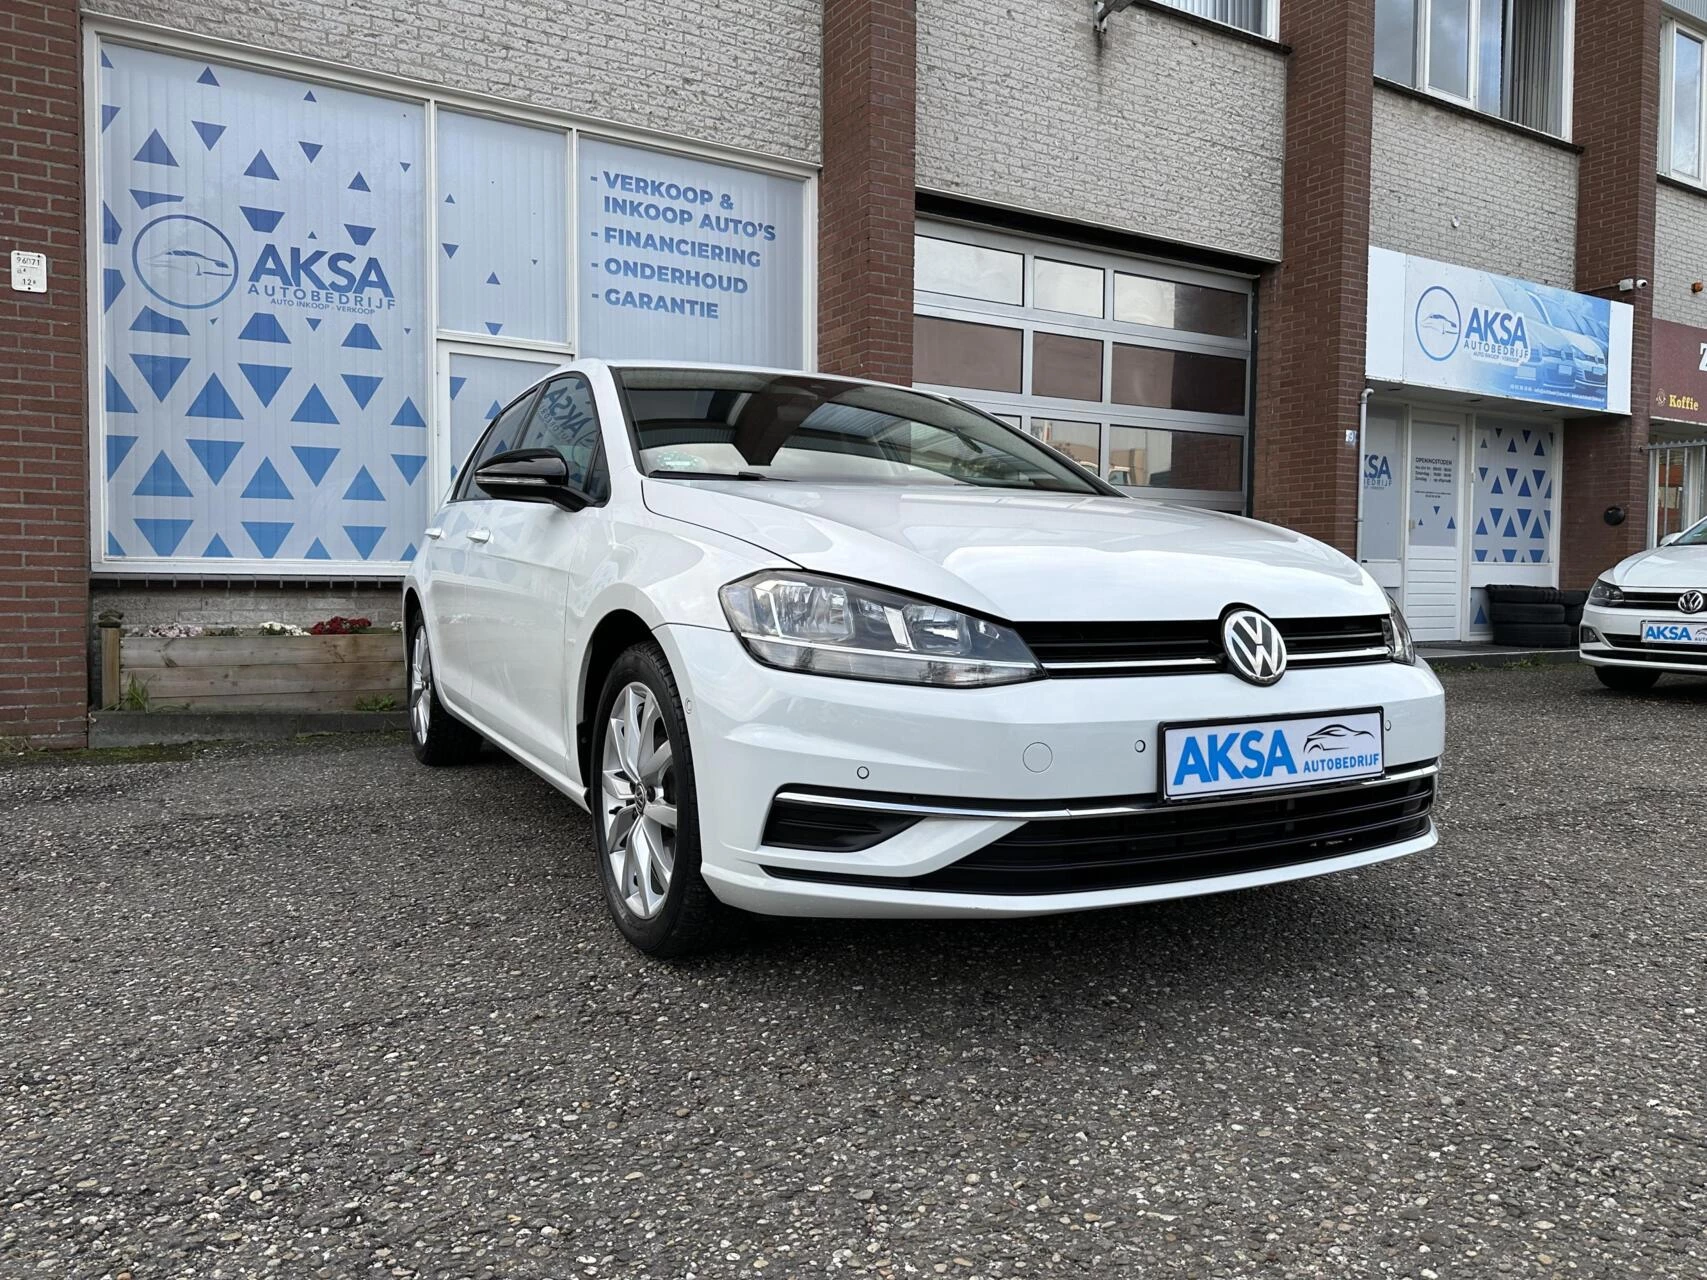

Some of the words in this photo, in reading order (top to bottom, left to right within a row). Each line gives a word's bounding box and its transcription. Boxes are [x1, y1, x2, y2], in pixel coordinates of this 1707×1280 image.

[602, 170, 713, 206] VERKOOP
[719, 193, 734, 210] &
[604, 195, 693, 225] INKOOP
[699, 213, 776, 242] AUTO'S
[604, 226, 761, 268] FINANCIERING
[248, 243, 395, 298] AKSA
[604, 257, 748, 294] ONDERHOUD
[247, 283, 396, 311] AUTOBEDRIJF
[270, 298, 295, 307] AUTO
[296, 301, 330, 310] INKOOP
[336, 305, 376, 315] VERKOOP
[604, 288, 720, 320] GARANTIE
[1464, 307, 1529, 349] AKSA
[1464, 340, 1529, 359] AUTOBEDRIJF
[1669, 394, 1699, 411] Koffie
[1645, 626, 1692, 641] AKSA
[1173, 729, 1297, 786] AKSA
[1303, 753, 1379, 773] AUTOBEDRIJF
